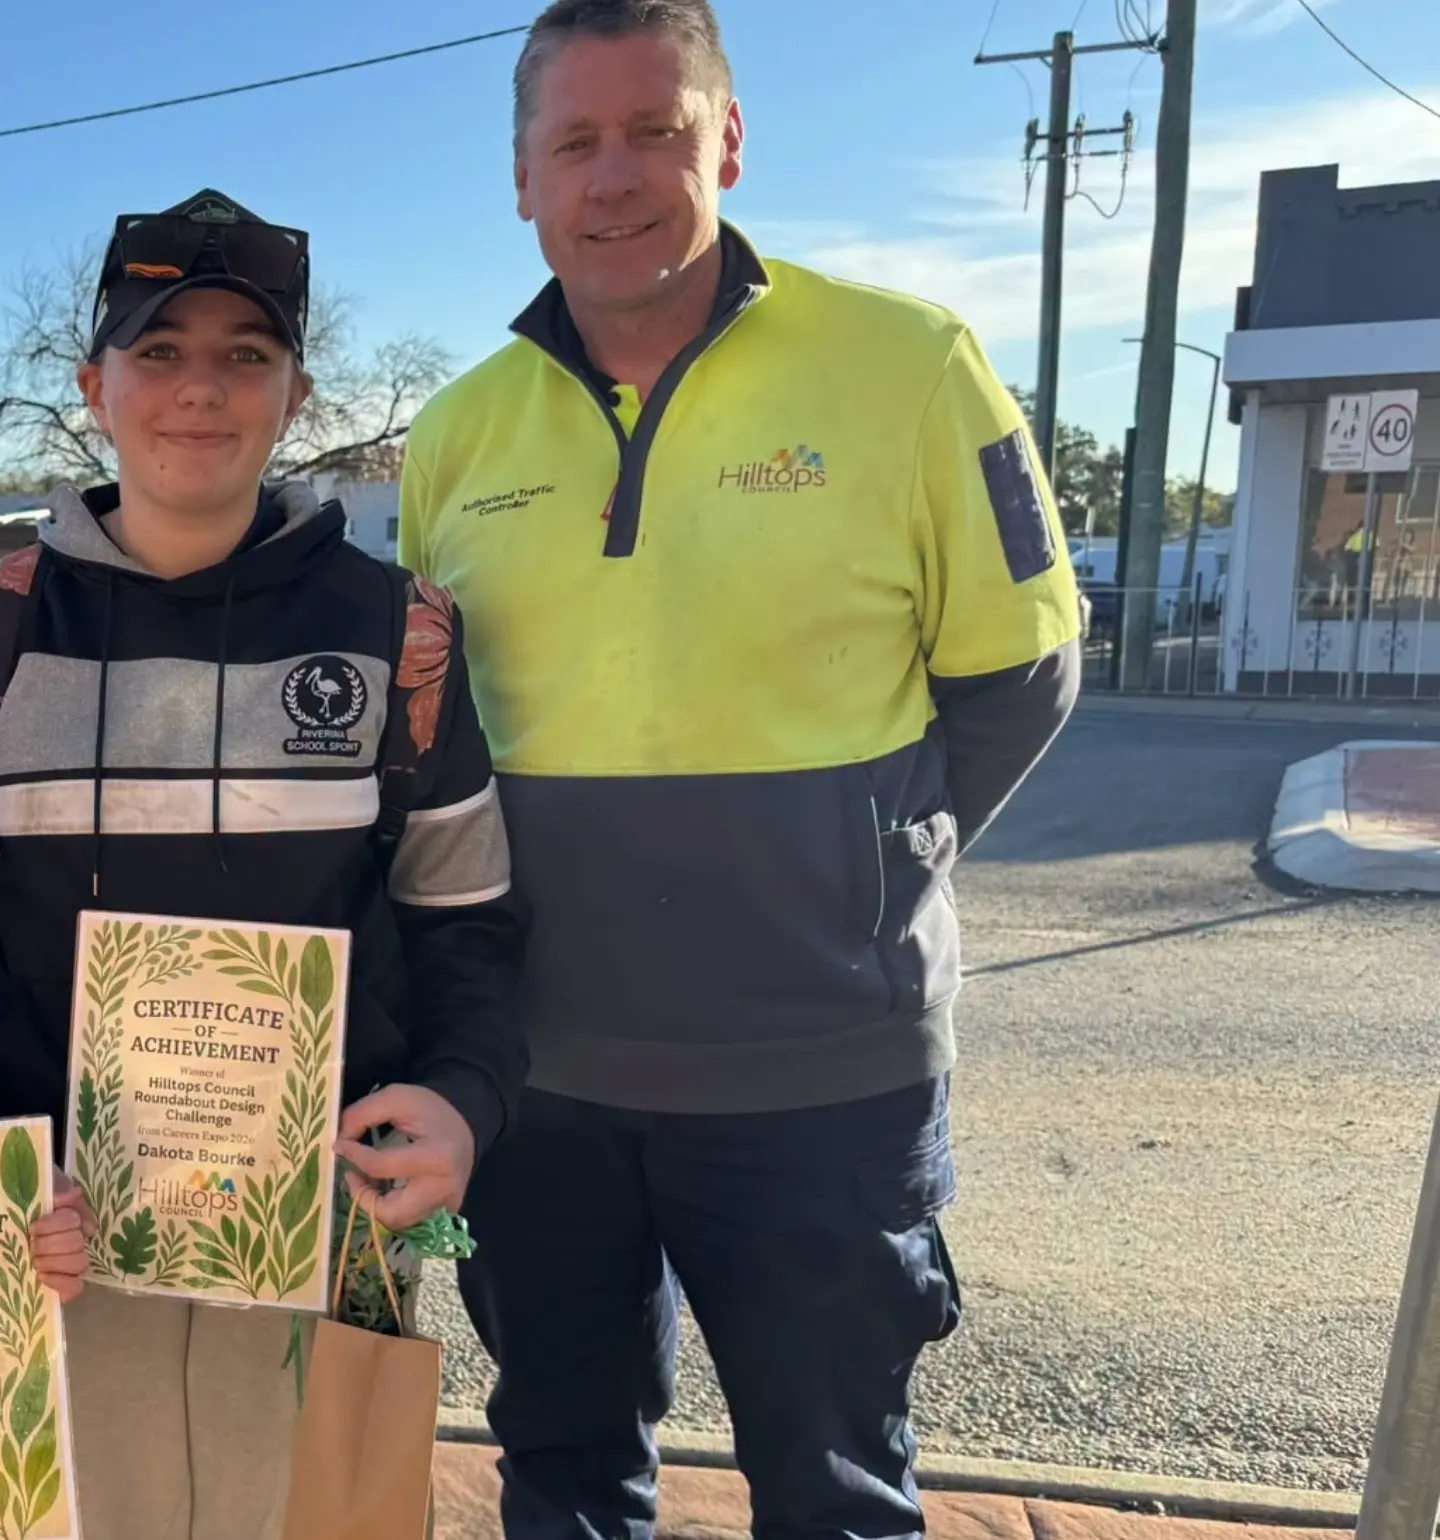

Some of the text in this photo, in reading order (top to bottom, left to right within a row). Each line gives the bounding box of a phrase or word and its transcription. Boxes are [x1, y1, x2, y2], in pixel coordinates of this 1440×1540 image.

[1375, 417, 1408, 443] 40
[718, 461, 826, 493] Hilltops
[461, 484, 555, 513] Authorised Traffic
[741, 486, 792, 494] COUNCIL
[287, 741, 359, 752] SCHOOL SPORT
[133, 999, 285, 1031] CERTIFICATE
[194, 1024, 218, 1038] OF
[130, 1036, 280, 1064] ACHIEVEMENT
[180, 1066, 226, 1079] Winner of
[148, 1076, 256, 1098] Hilltops Council
[134, 1090, 265, 1116] Roundabout Design
[165, 1108, 233, 1128] Challenge
[137, 1125, 160, 1136] from
[162, 1126, 200, 1140] Careers
[202, 1131, 229, 1143] Expo
[137, 1143, 256, 1167] Dakota Bourke
[138, 1176, 239, 1218] Hilltops
[159, 1205, 204, 1218] COUNCIL
